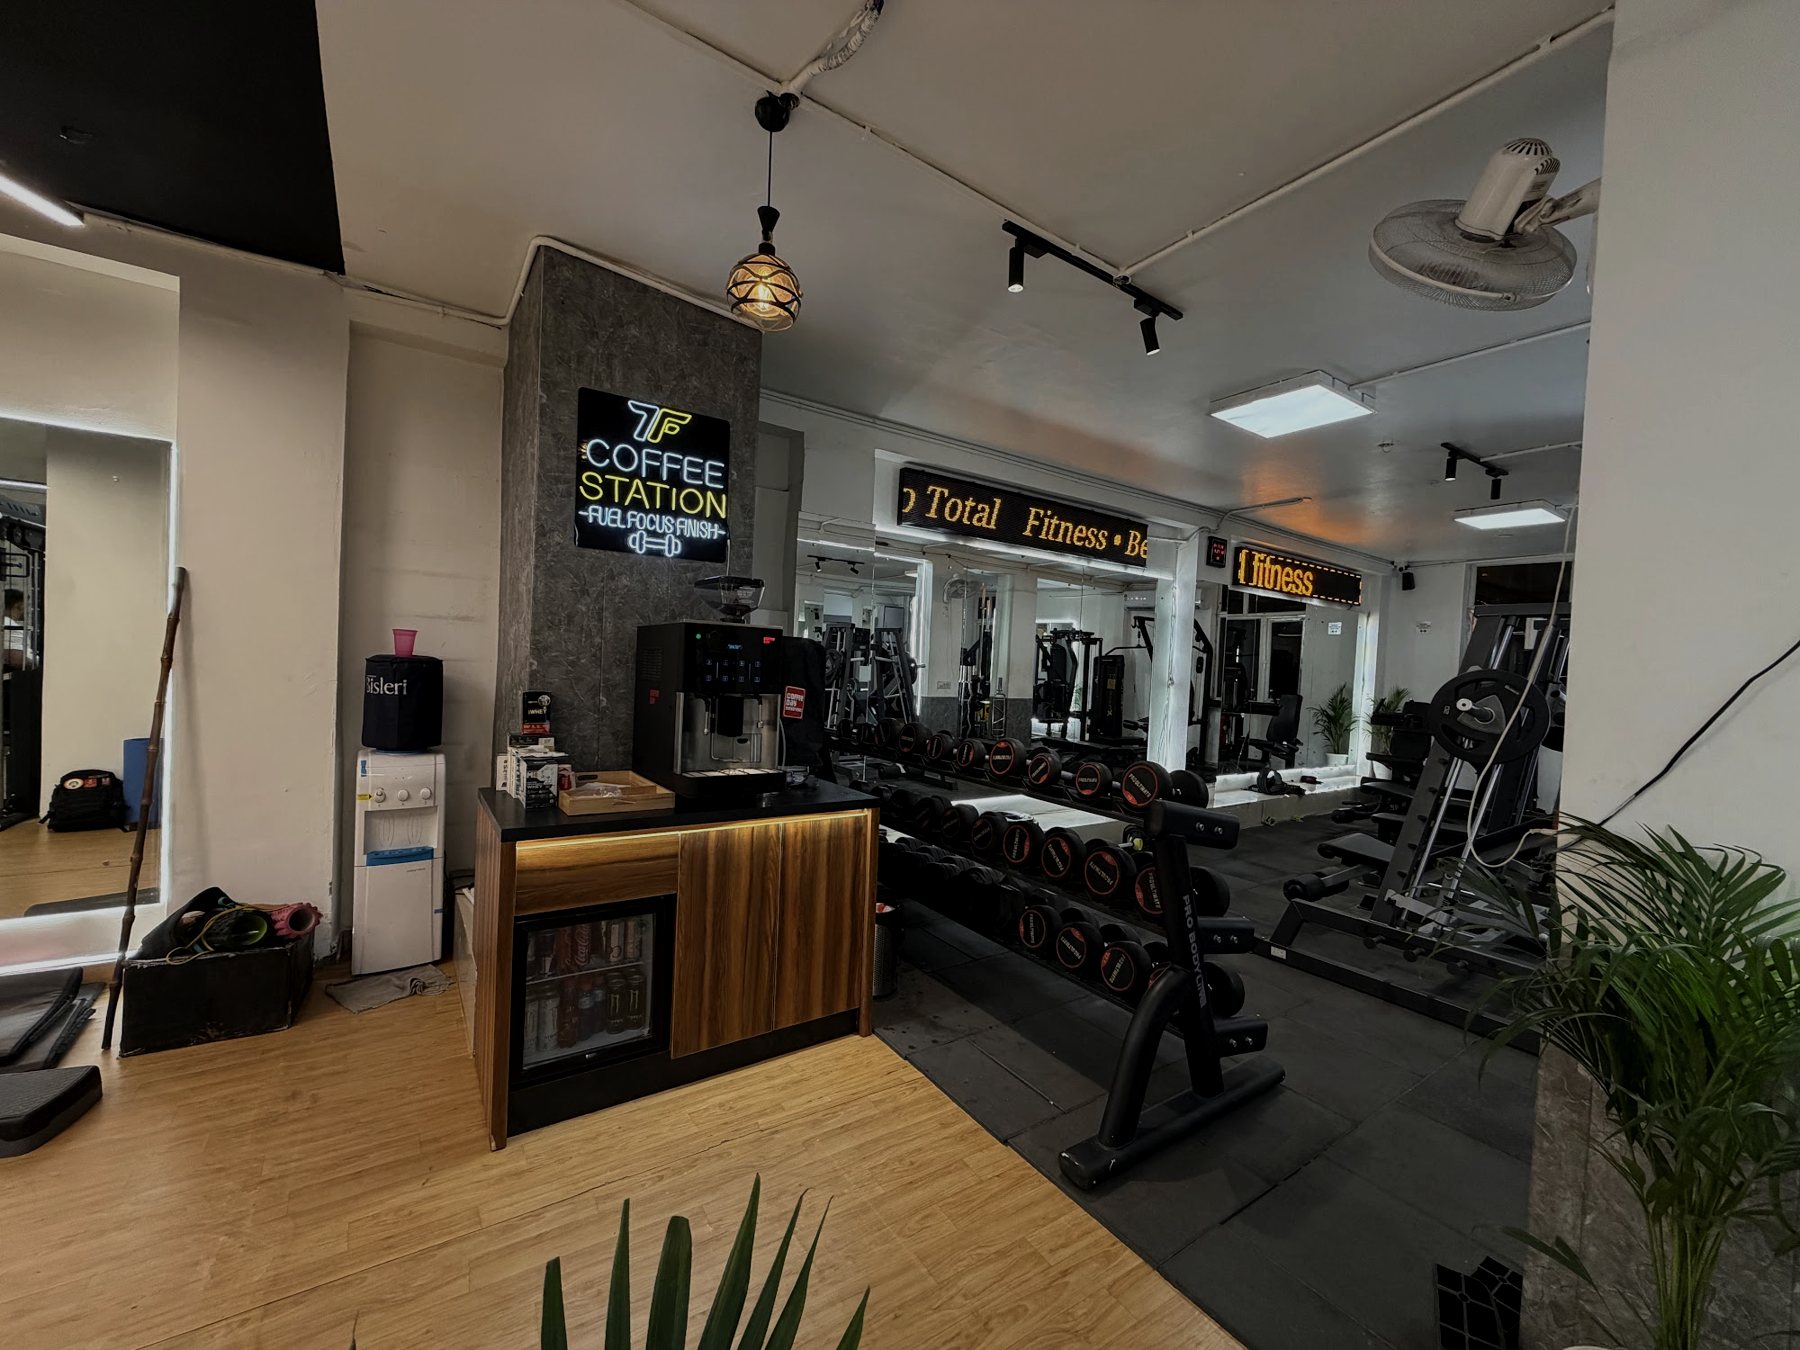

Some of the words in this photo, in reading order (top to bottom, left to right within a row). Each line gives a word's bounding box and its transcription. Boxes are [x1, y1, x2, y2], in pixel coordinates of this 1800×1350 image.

[586, 438, 725, 489] COFFEE
[579, 471, 727, 519] STATION
[925, 485, 1002, 530] Total
[1022, 507, 1109, 550] Fitness
[627, 511, 675, 534] FOCUS
[1182, 894, 1194, 929] PRO
